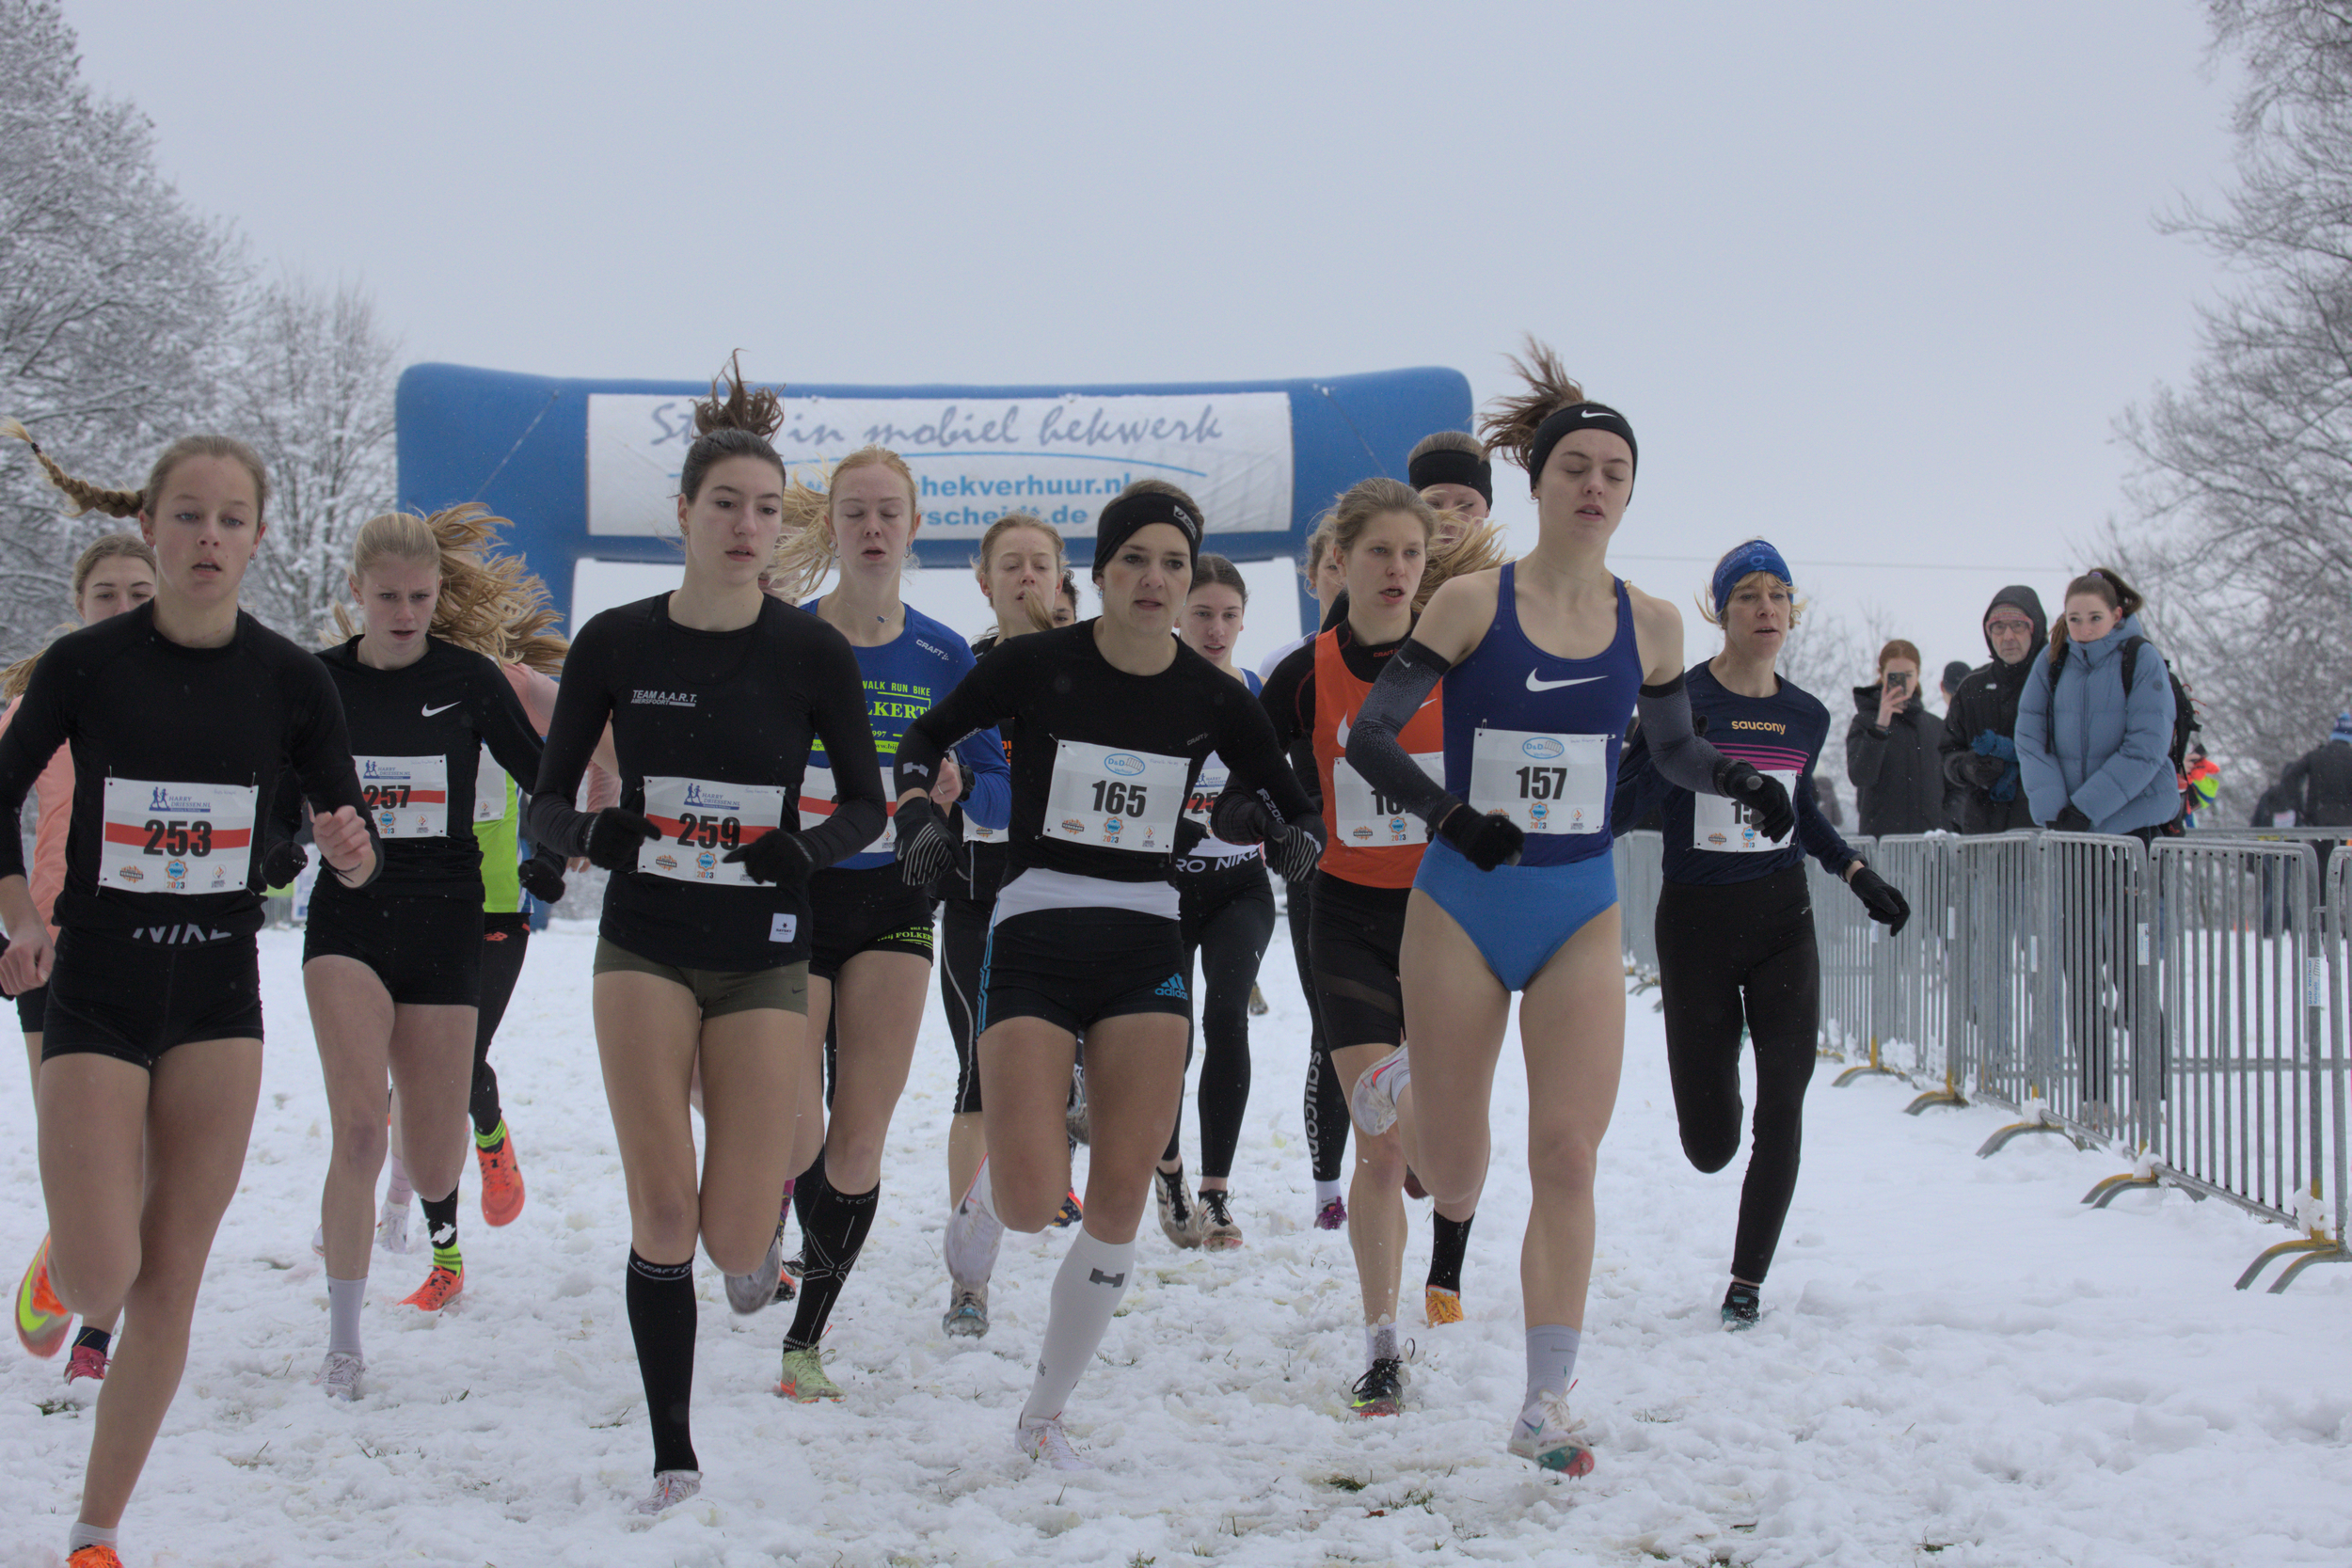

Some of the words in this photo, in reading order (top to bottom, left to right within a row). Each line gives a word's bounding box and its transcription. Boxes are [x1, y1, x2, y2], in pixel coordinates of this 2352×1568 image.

[863, 405, 1020, 447] mobiel
[1038, 404, 1223, 446] hekwerk
[915, 639, 945, 657] CRAFT
[632, 689, 659, 699] TEAM
[891, 682, 908, 693] RUN
[913, 686, 931, 696] BIKE
[1731, 721, 1786, 735] saucony
[1516, 766, 1567, 800] 157
[363, 784, 411, 810] 257
[1092, 780, 1147, 818] 165
[1191, 792, 1219, 816] 25
[677, 813, 740, 851] 259
[1530, 821, 1547, 830] 2023
[143, 819, 213, 858] 253
[1103, 835, 1120, 844] 2023
[1155, 987, 1188, 1000] adida
[835, 1194, 876, 1204] STOX
[636, 1260, 682, 1275] CRAFT
